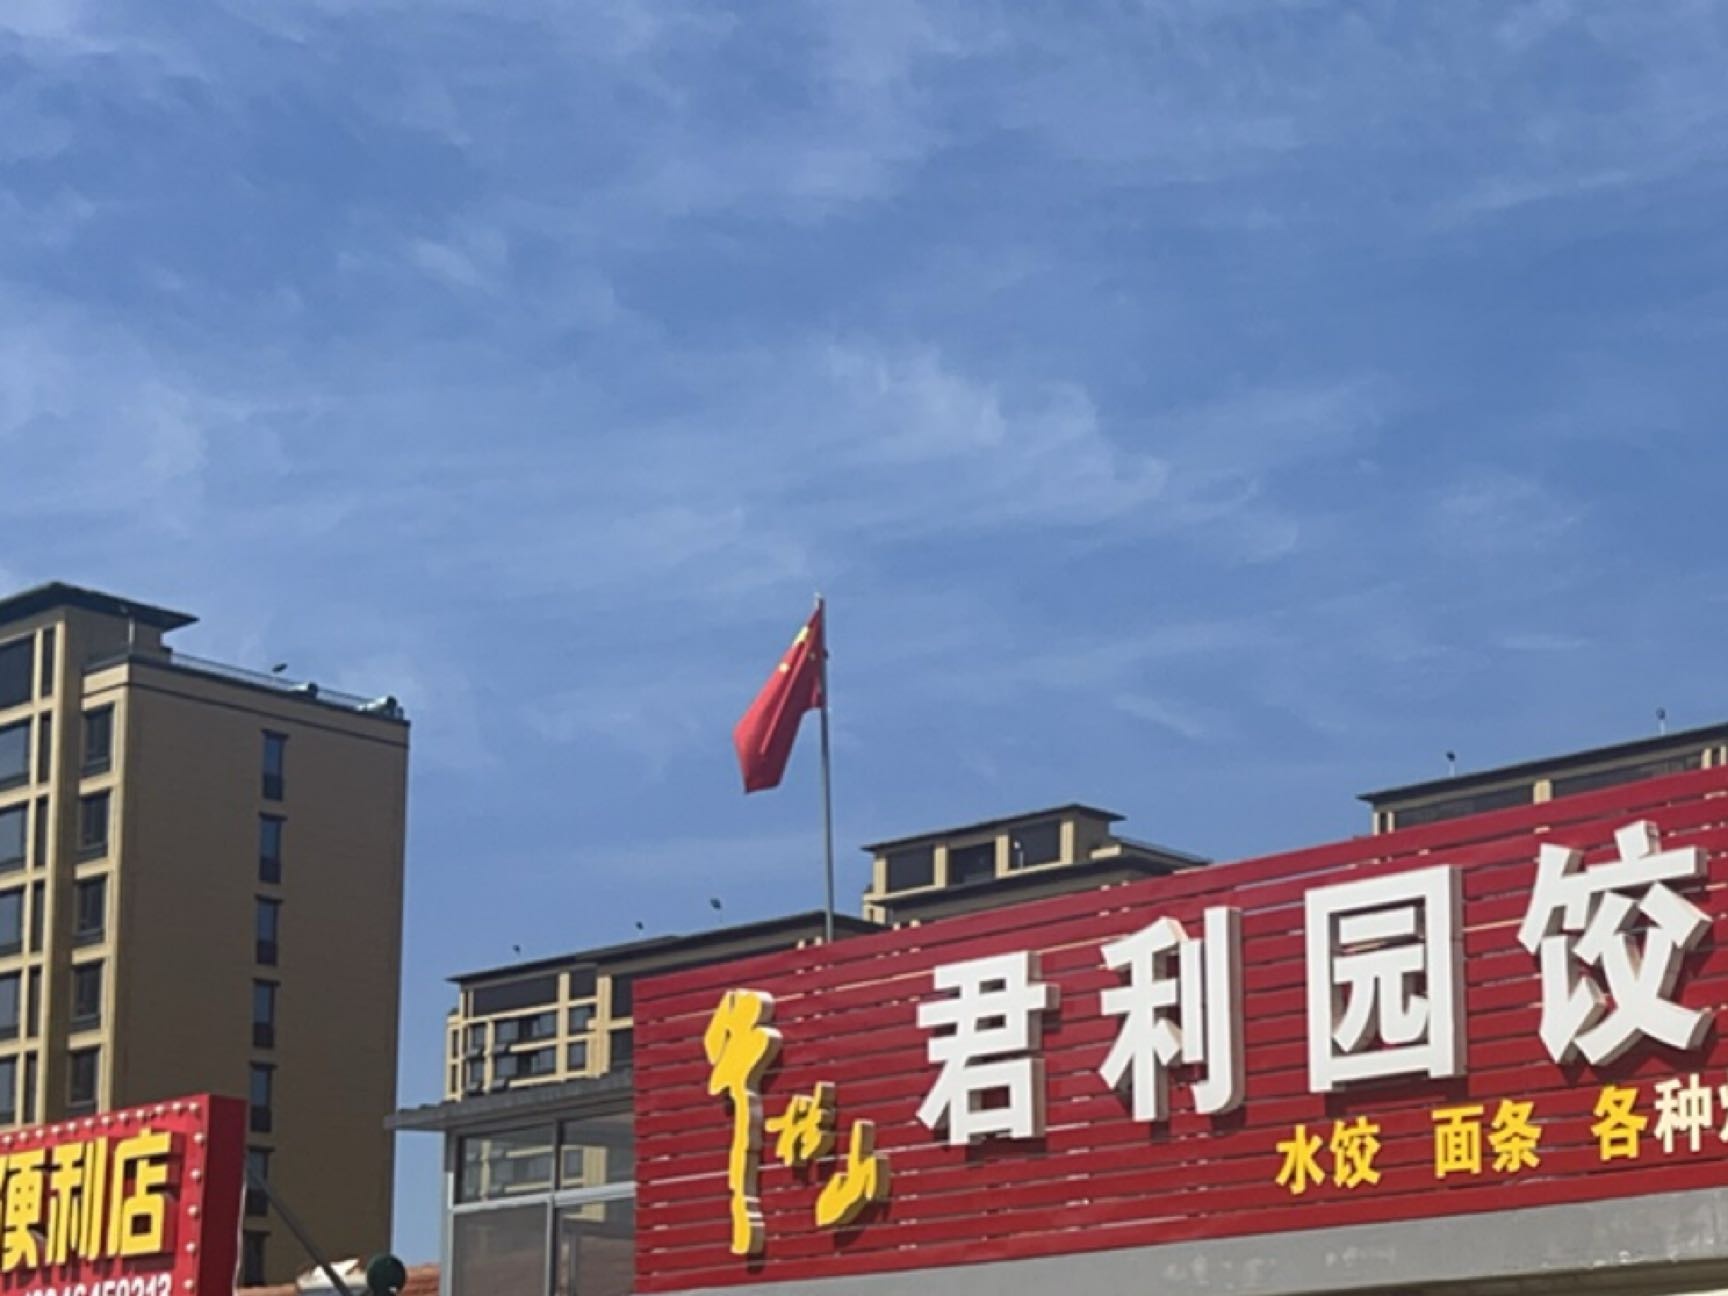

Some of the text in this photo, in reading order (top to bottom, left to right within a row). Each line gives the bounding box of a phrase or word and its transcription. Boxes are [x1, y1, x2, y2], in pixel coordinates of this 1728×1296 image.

[0, 1127, 171, 1273] 便利店
[1275, 1116, 1382, 1194] 水饺
[1433, 1099, 1542, 1181] 面条
